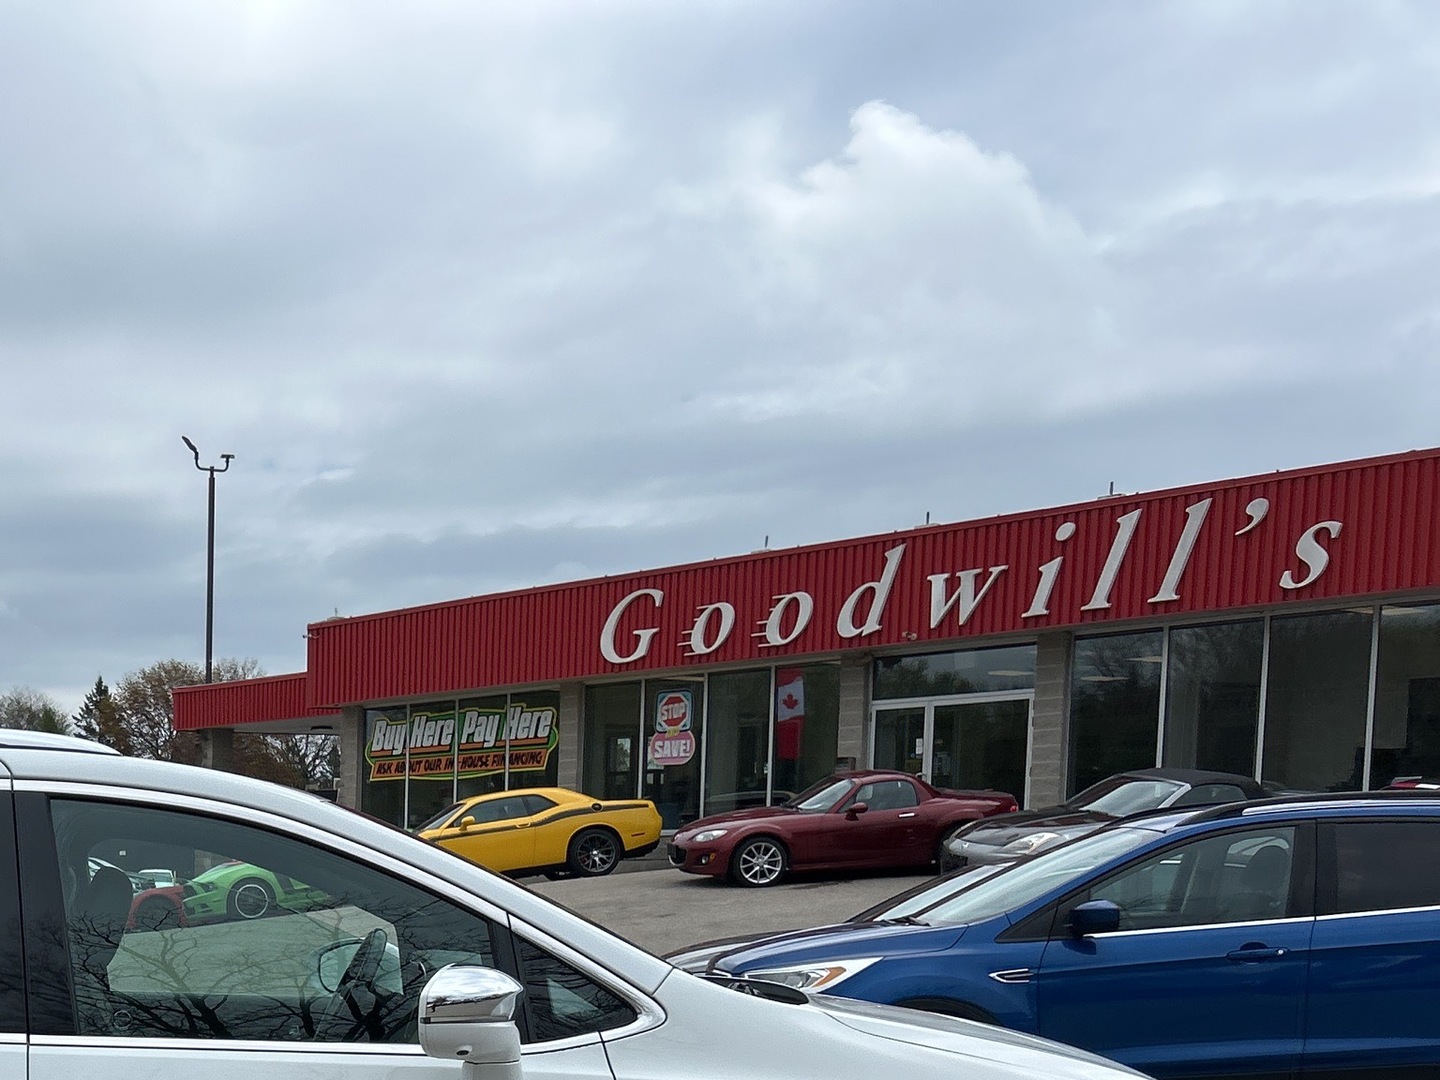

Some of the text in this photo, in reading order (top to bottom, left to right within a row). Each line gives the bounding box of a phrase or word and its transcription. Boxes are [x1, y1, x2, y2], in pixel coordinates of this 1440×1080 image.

[599, 496, 1343, 664] Goodwill's
[661, 702, 686, 721] STOP
[371, 706, 553, 755] Buy Here Pay Here
[654, 739, 691, 758] SAVE!
[376, 762, 394, 775] ASK
[424, 758, 442, 772] OUR
[491, 751, 543, 767] FINANCING
